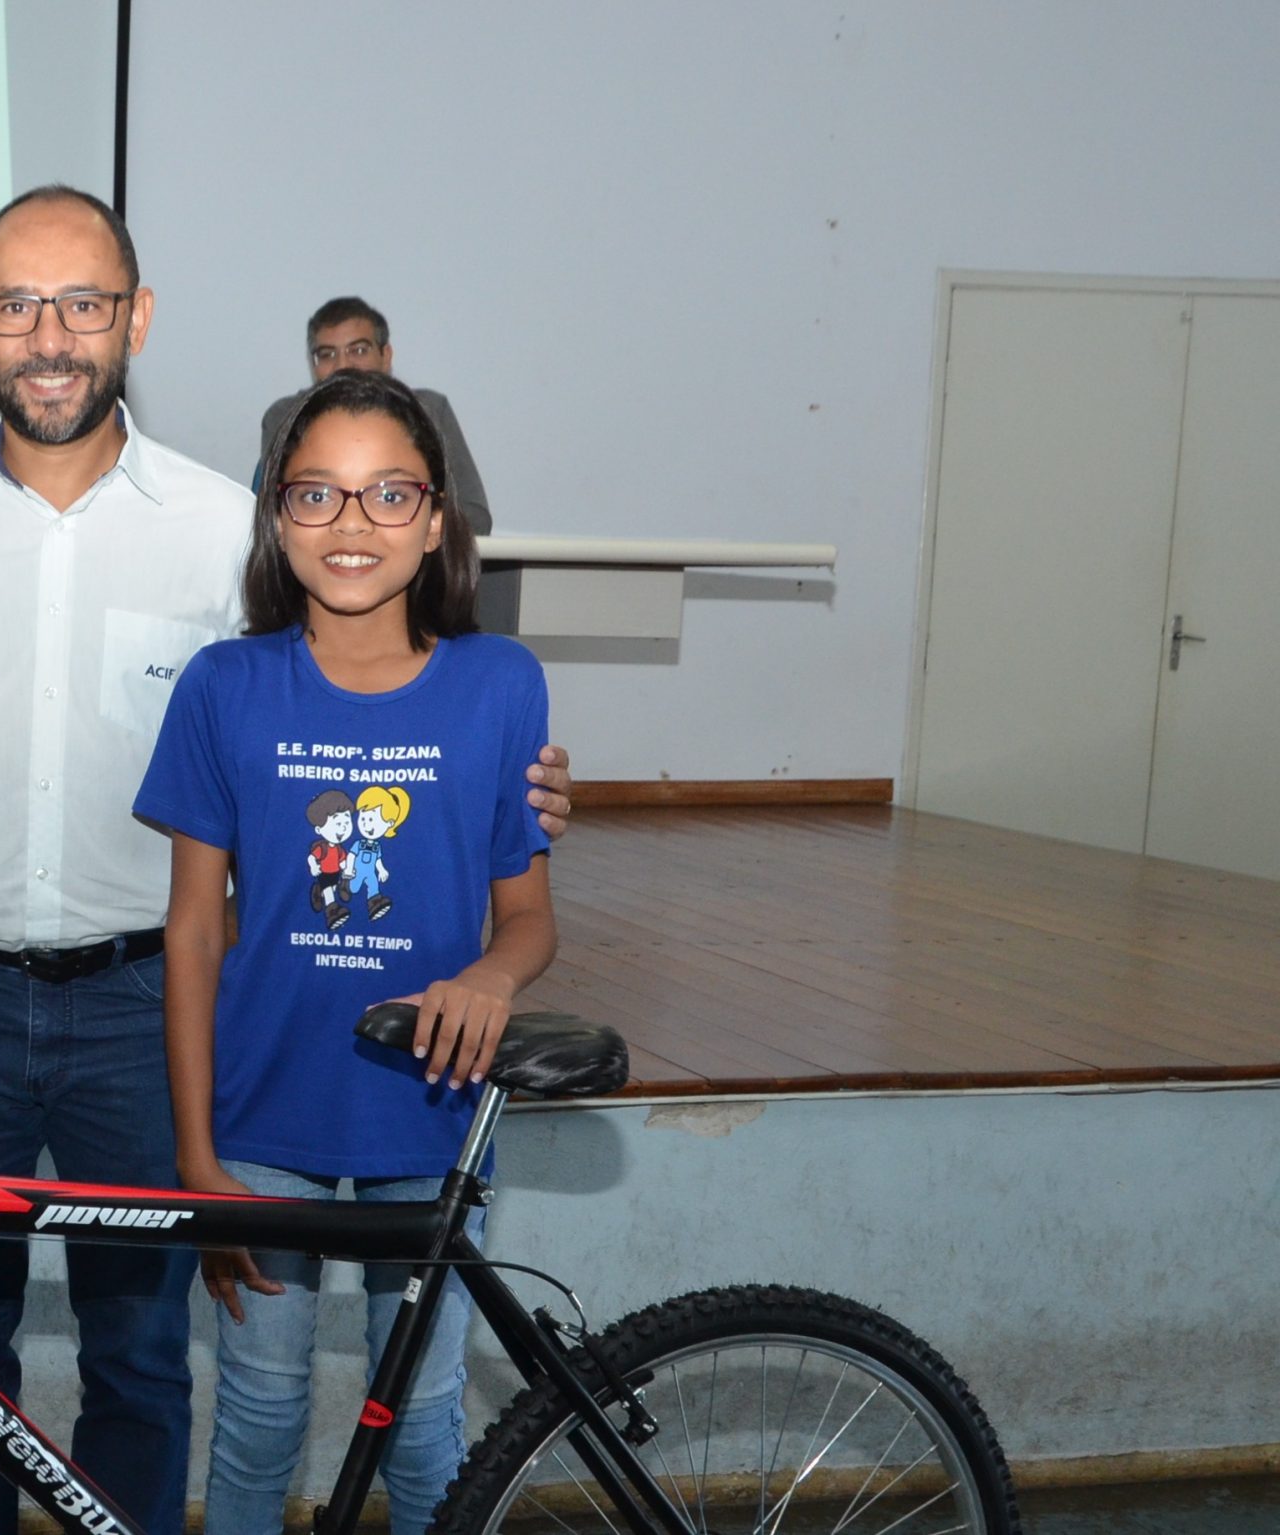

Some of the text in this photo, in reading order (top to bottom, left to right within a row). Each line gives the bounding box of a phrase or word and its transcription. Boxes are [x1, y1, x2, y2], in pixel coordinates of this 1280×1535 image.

[144, 664, 177, 681] ACIF
[276, 742, 308, 757] E.E.
[371, 745, 442, 761] SUZANA
[277, 764, 438, 783] RIBEIRO SANDOVAL
[290, 932, 413, 951] ESCOLA DE TEMPO
[315, 953, 385, 970] INTEGRAL
[34, 1205, 195, 1230] power
